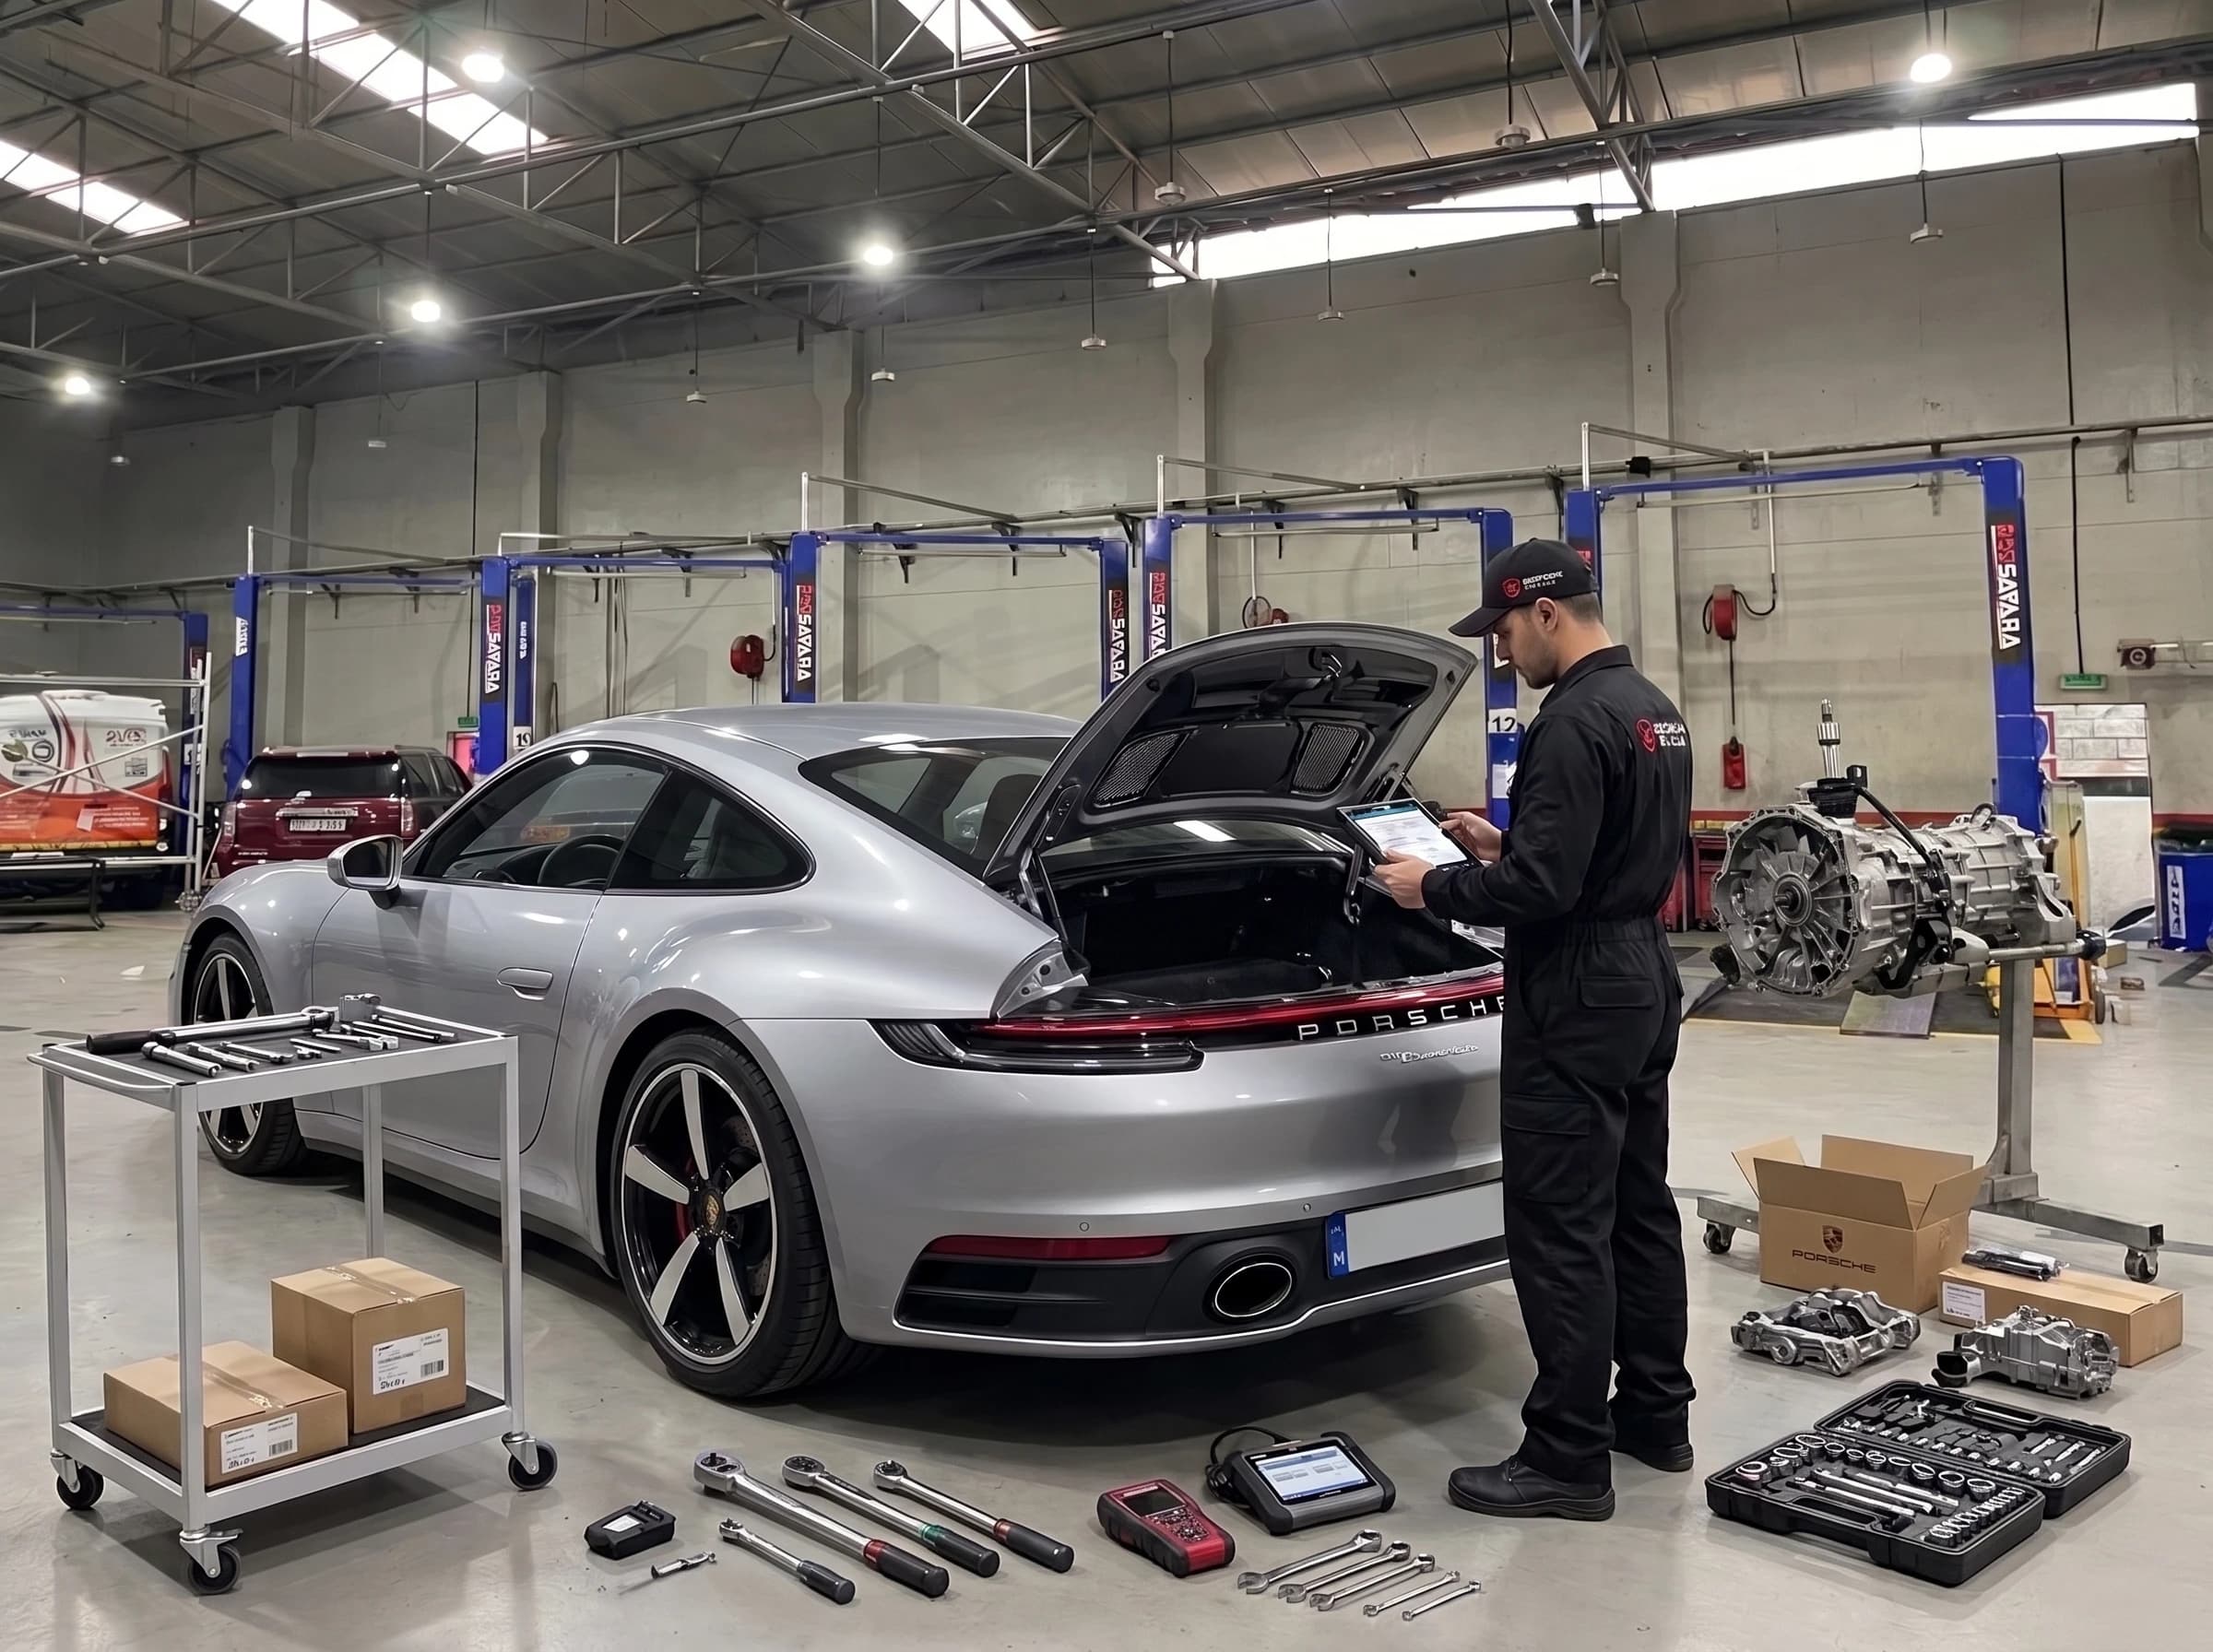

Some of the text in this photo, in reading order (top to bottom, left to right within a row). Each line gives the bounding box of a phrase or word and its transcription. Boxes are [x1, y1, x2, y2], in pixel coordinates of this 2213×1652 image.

[1997, 563, 2021, 650] SAVARA
[1151, 603, 1166, 658] SAVA
[1492, 715, 1517, 732] 12
[1333, 1250, 1345, 1267] M
[1792, 1249, 1876, 1274] PORSCHE
